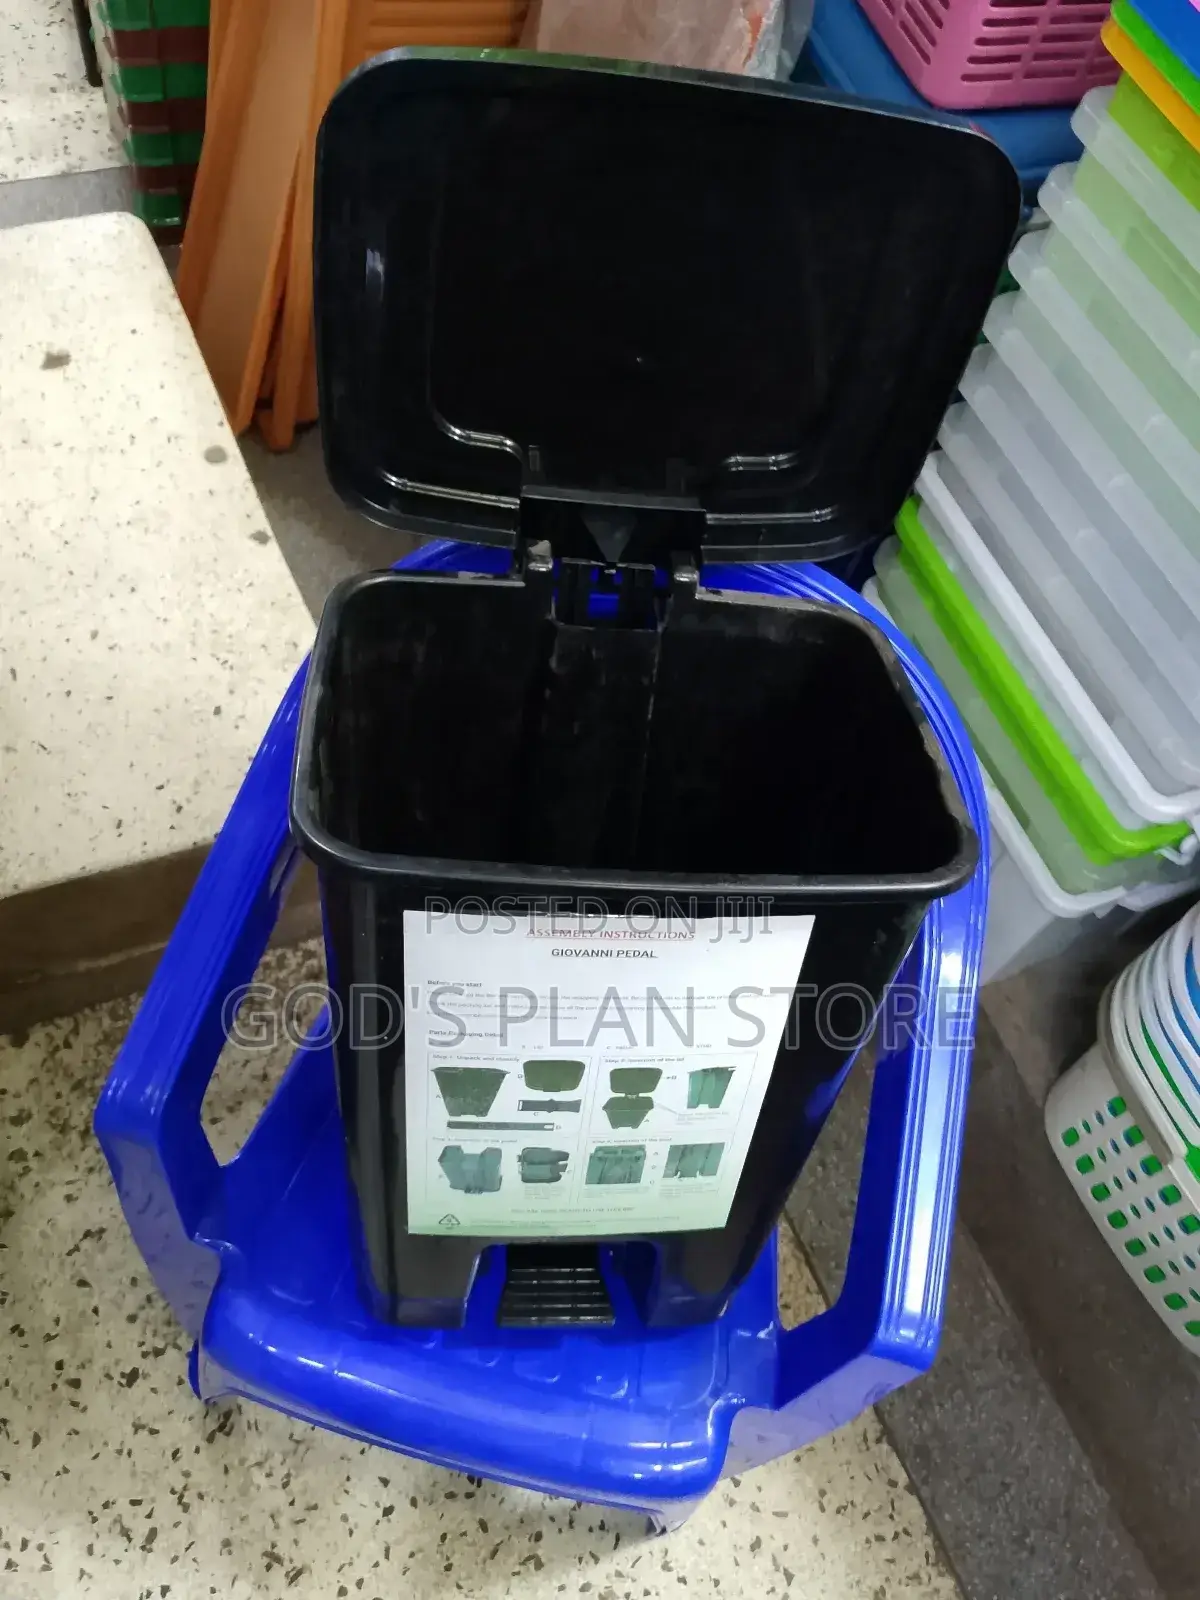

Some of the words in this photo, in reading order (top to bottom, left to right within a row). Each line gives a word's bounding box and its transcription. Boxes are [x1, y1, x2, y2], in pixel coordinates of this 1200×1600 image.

[527, 928, 596, 938] ASSEMBLY
[599, 930, 695, 939] INSTRUCTIONS
[551, 948, 613, 958] GIOVANNI
[616, 949, 658, 958] PEDAL
